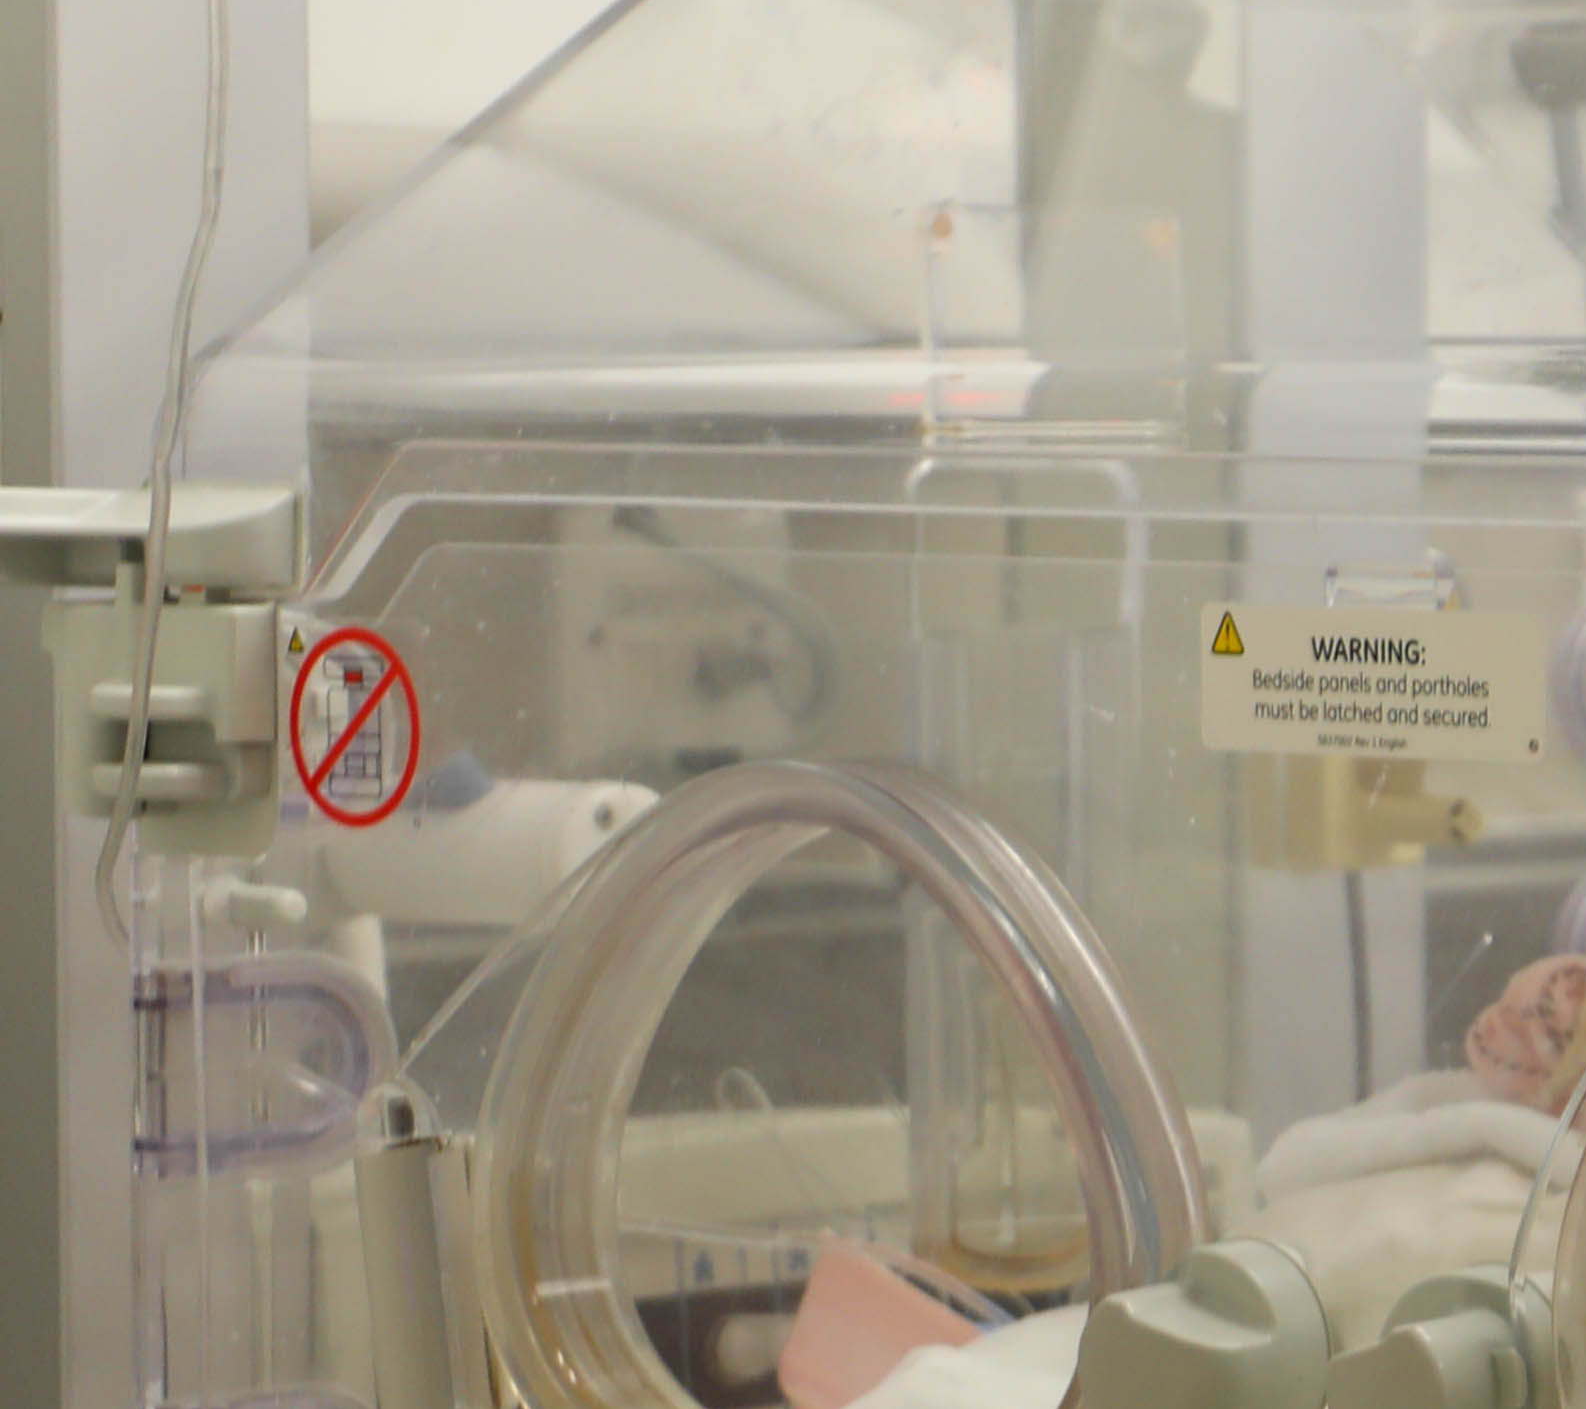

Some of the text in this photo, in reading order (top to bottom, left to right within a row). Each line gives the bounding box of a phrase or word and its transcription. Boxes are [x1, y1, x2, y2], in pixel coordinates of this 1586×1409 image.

[1311, 635, 1426, 666] WARNING:
[1252, 668, 1489, 700] Bedside panels and portholes
[1255, 699, 1491, 728] must be latched and secured.
